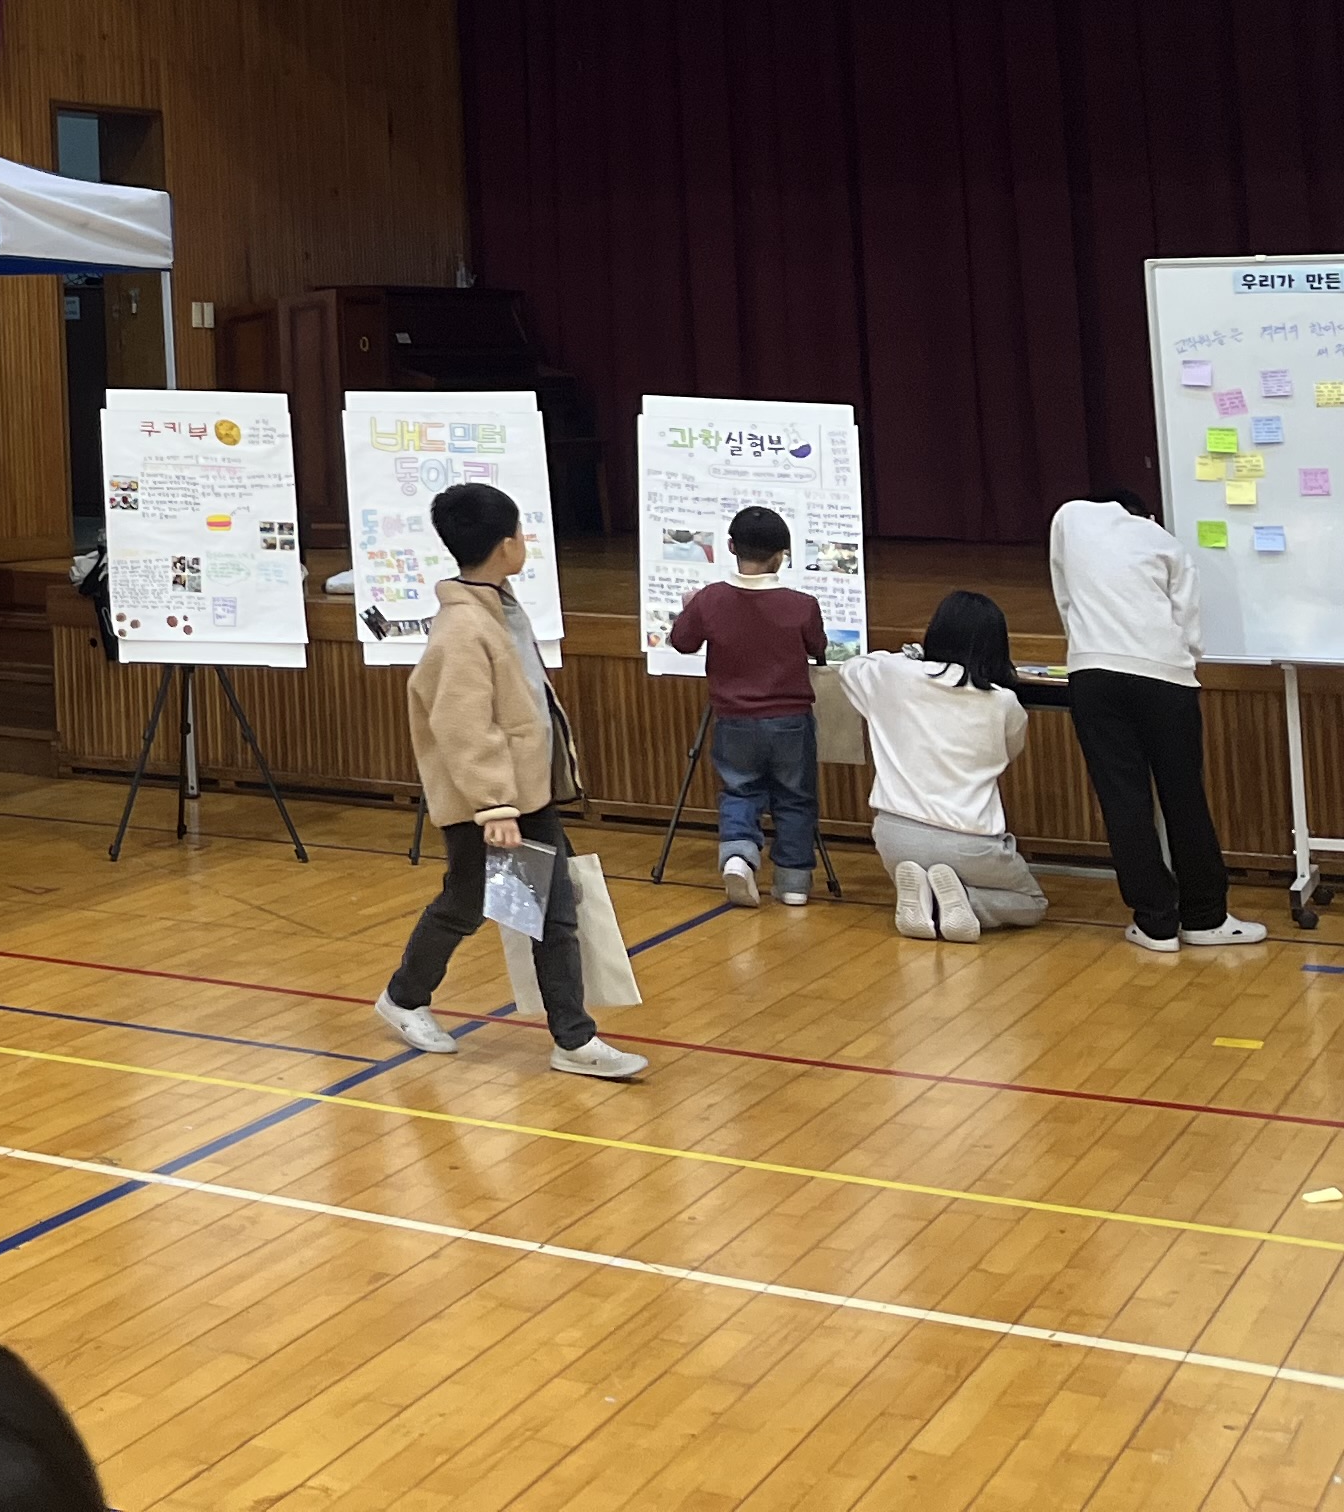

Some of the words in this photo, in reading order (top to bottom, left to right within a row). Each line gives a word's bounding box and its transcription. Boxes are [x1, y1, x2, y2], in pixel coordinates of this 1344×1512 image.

[1241, 273, 1296, 290] 우리가
[1305, 272, 1342, 290] 만든
[140, 421, 208, 440] 쿠키부
[370, 416, 507, 454] 배드민턴
[667, 427, 786, 457] 과학실험부
